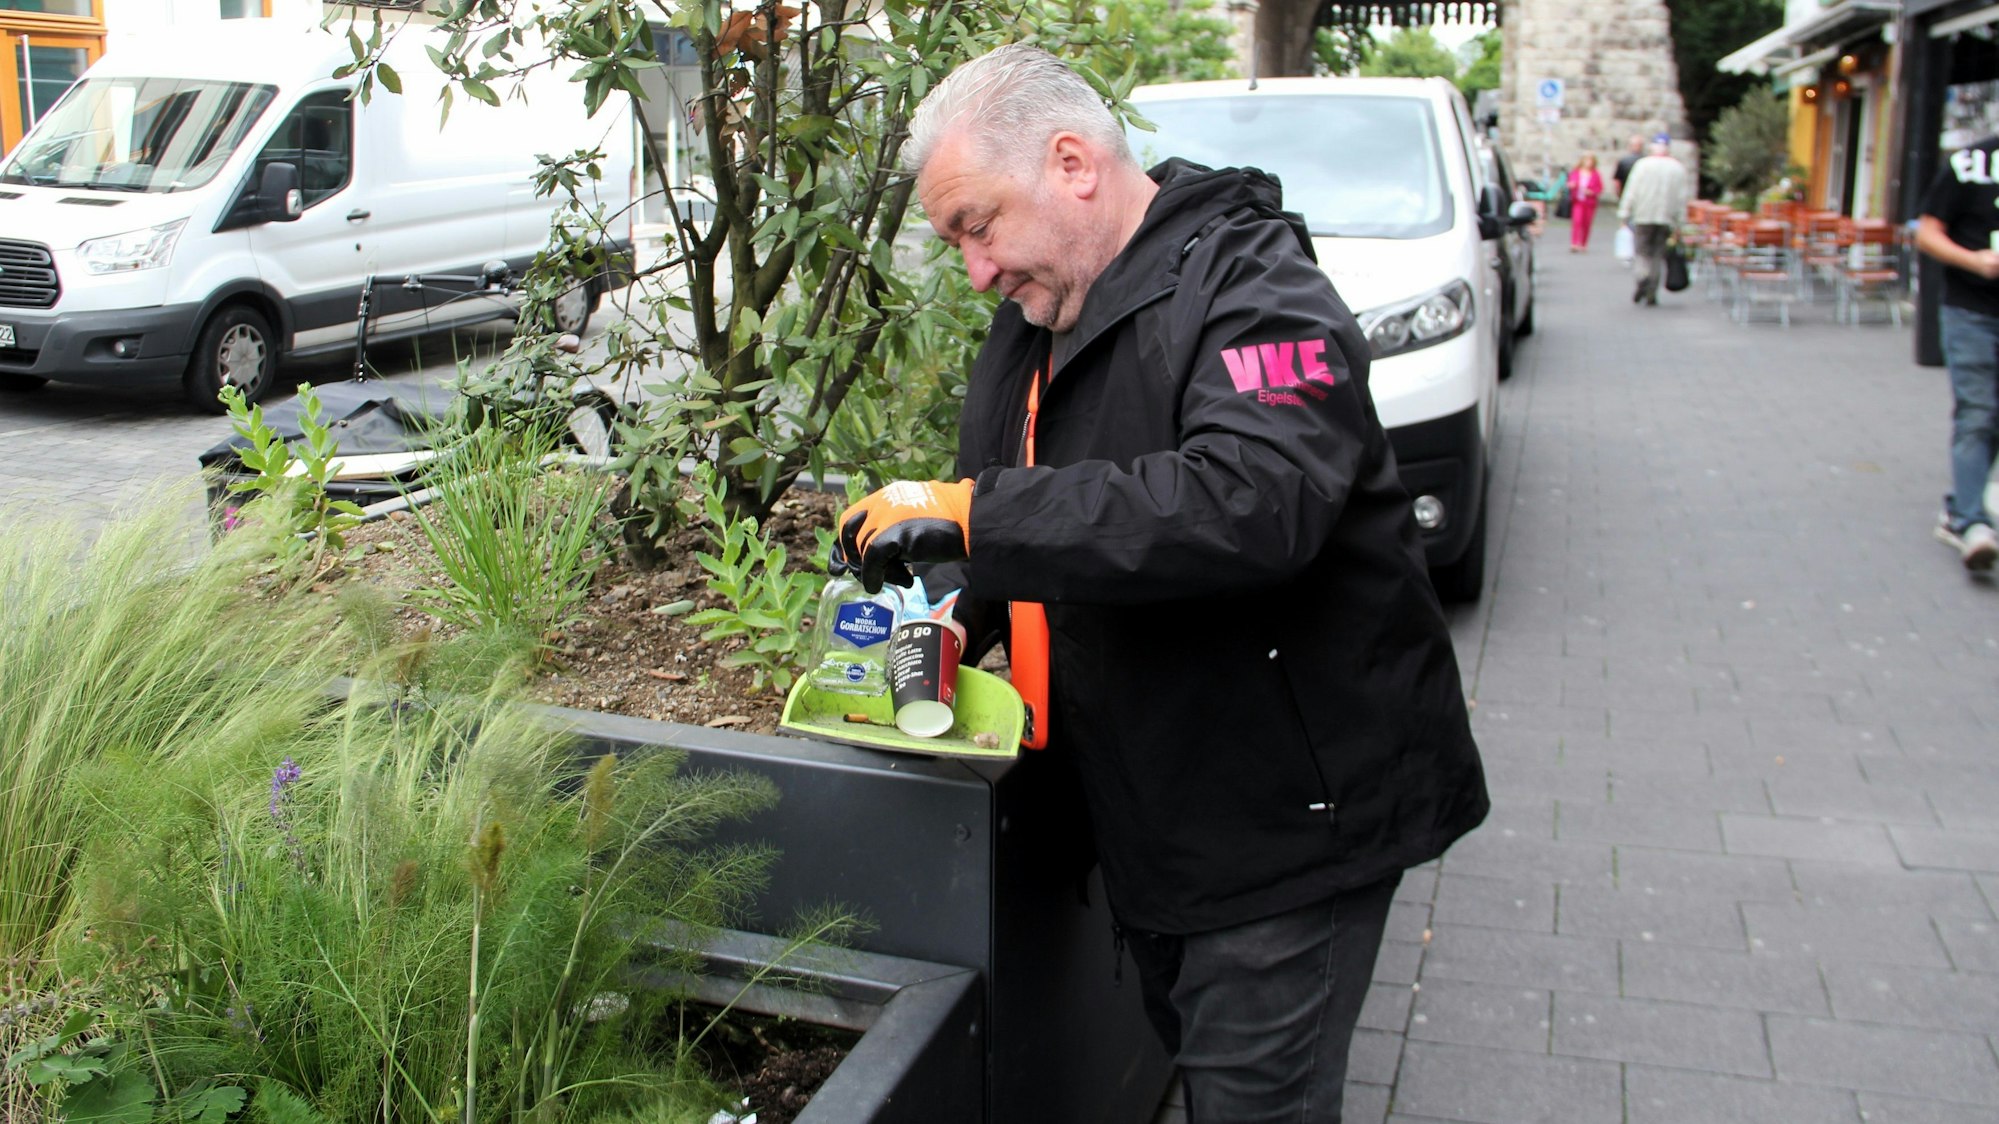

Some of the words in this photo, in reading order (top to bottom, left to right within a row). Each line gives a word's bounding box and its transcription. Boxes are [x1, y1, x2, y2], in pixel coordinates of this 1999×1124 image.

[1220, 338, 1335, 394] VKE
[854, 617, 877, 626] WODKA
[913, 626, 932, 639] go
